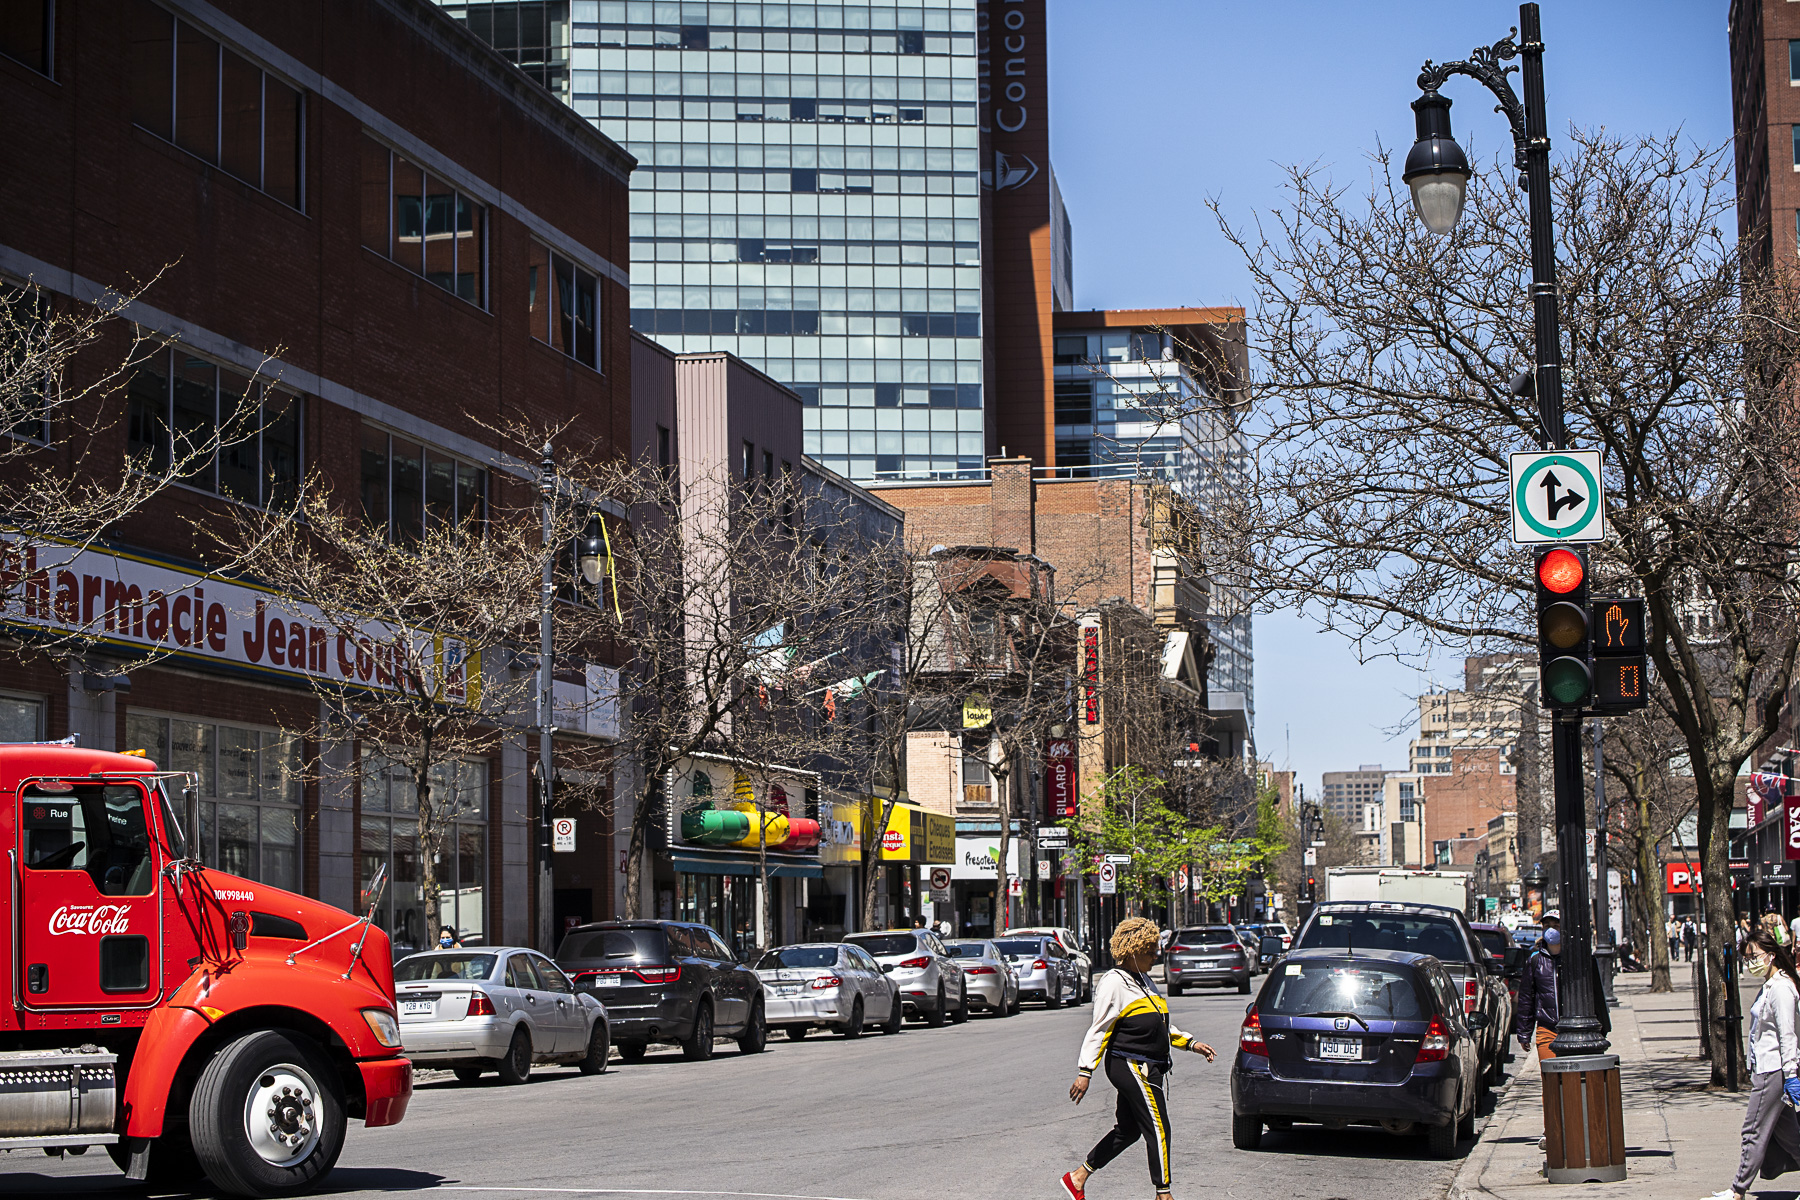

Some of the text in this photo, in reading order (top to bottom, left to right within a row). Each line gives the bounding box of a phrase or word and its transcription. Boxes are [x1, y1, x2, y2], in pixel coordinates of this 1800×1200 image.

[995, 0, 1027, 132] Conco
[0, 540, 227, 652] Pharmacie
[243, 600, 327, 673] Jean
[1056, 764, 1067, 815] BILLARD
[50, 809, 68, 818] Rue
[1789, 806, 1800, 849] SAQ
[883, 832, 904, 841] nsta
[48, 904, 132, 936] Coca-Cola
[1343, 1043, 1360, 1055] DEF
